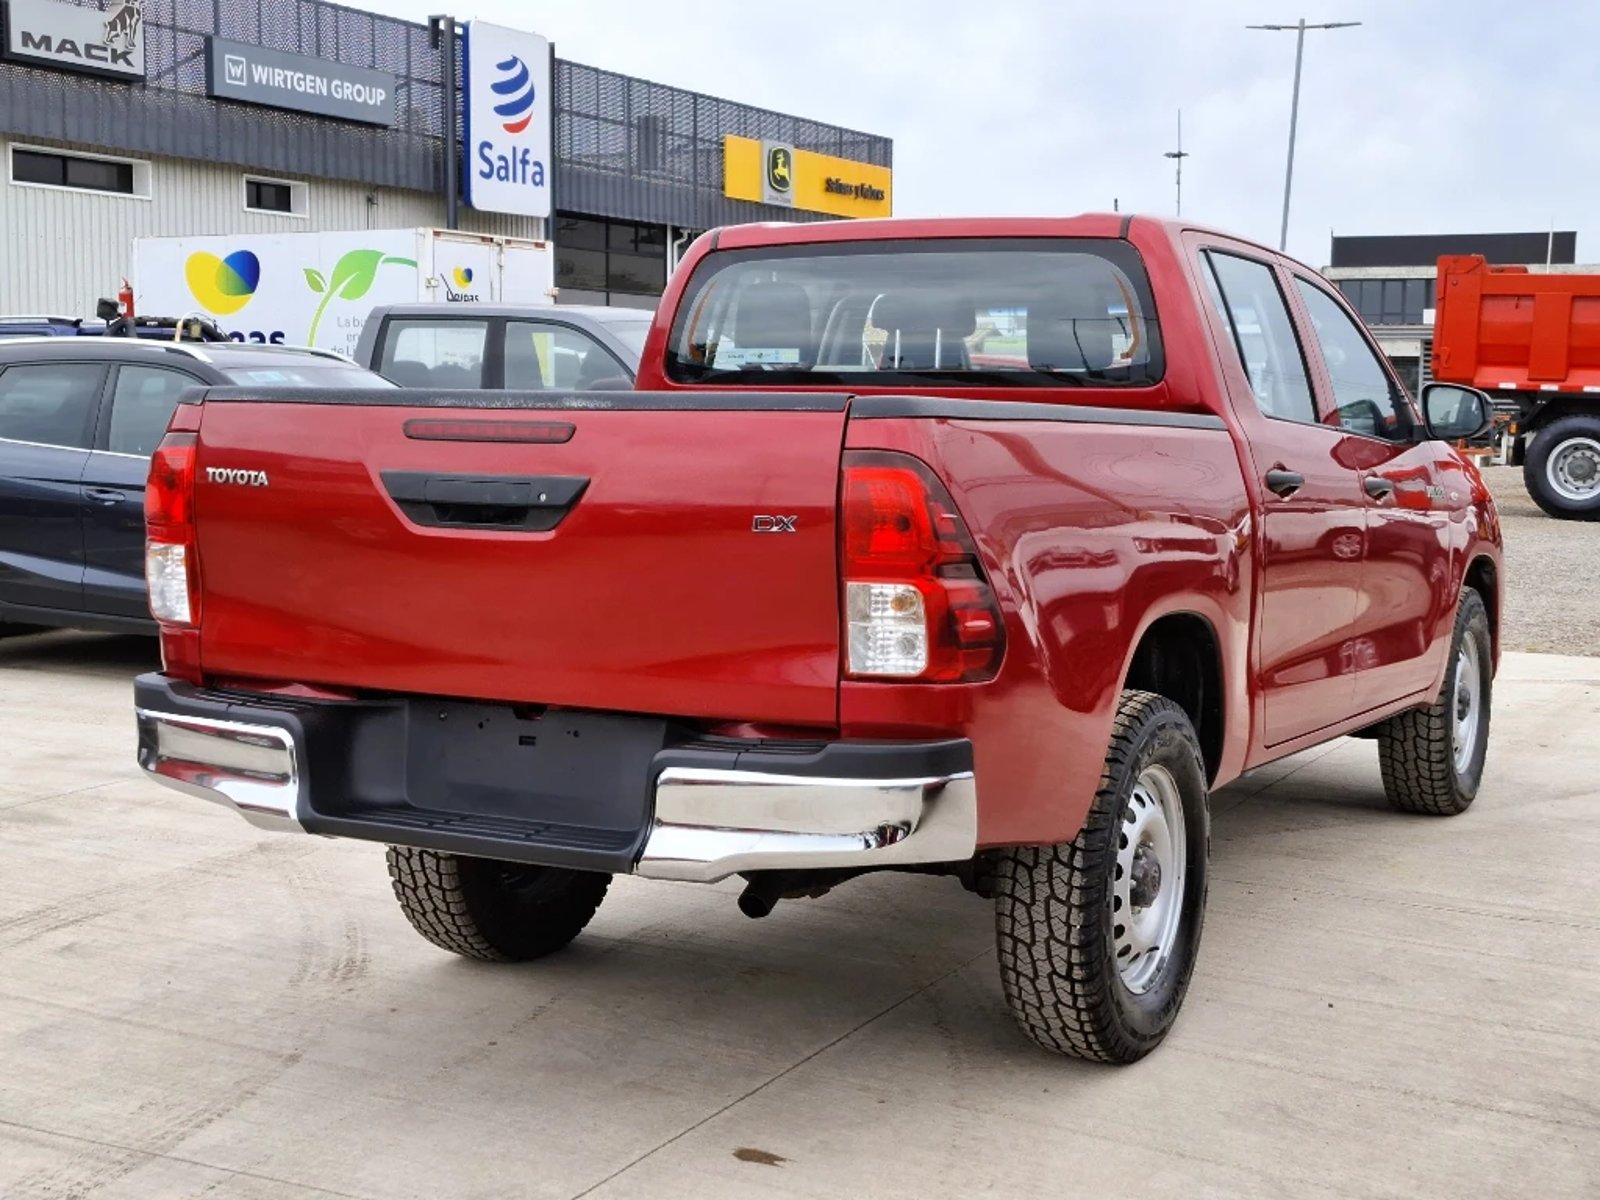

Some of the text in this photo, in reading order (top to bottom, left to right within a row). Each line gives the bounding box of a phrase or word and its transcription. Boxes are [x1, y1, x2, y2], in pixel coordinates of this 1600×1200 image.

[21, 30, 135, 68] MACK
[251, 63, 328, 97] WIRTGEN
[331, 79, 386, 107] GROUP
[478, 140, 545, 188] Salfa
[206, 466, 269, 487] TOYOTA
[752, 514, 798, 532] DX
